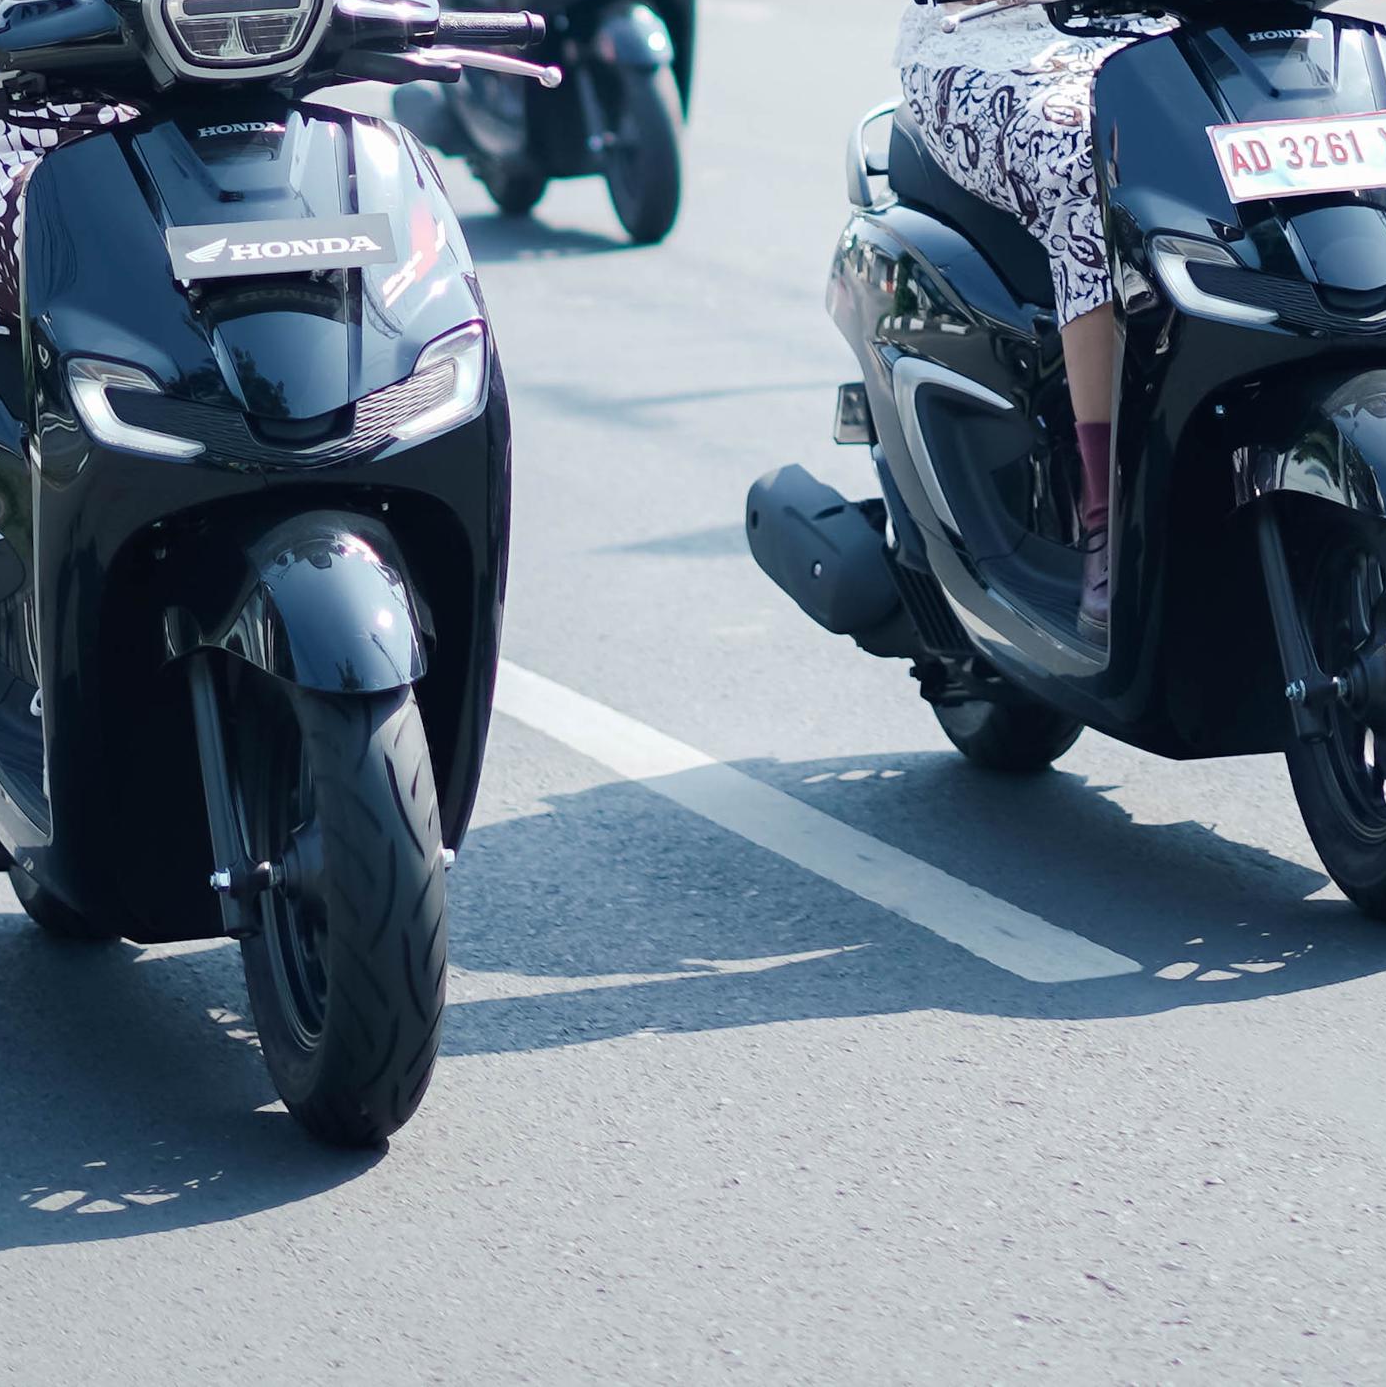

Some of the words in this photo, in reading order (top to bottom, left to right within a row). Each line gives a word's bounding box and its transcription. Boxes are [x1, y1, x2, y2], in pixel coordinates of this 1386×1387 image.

[1247, 28, 1324, 41] HONDA
[197, 122, 286, 138] HONDA
[1227, 139, 1272, 176] AD
[1279, 128, 1365, 170] 3261
[228, 235, 382, 261] HONDA
